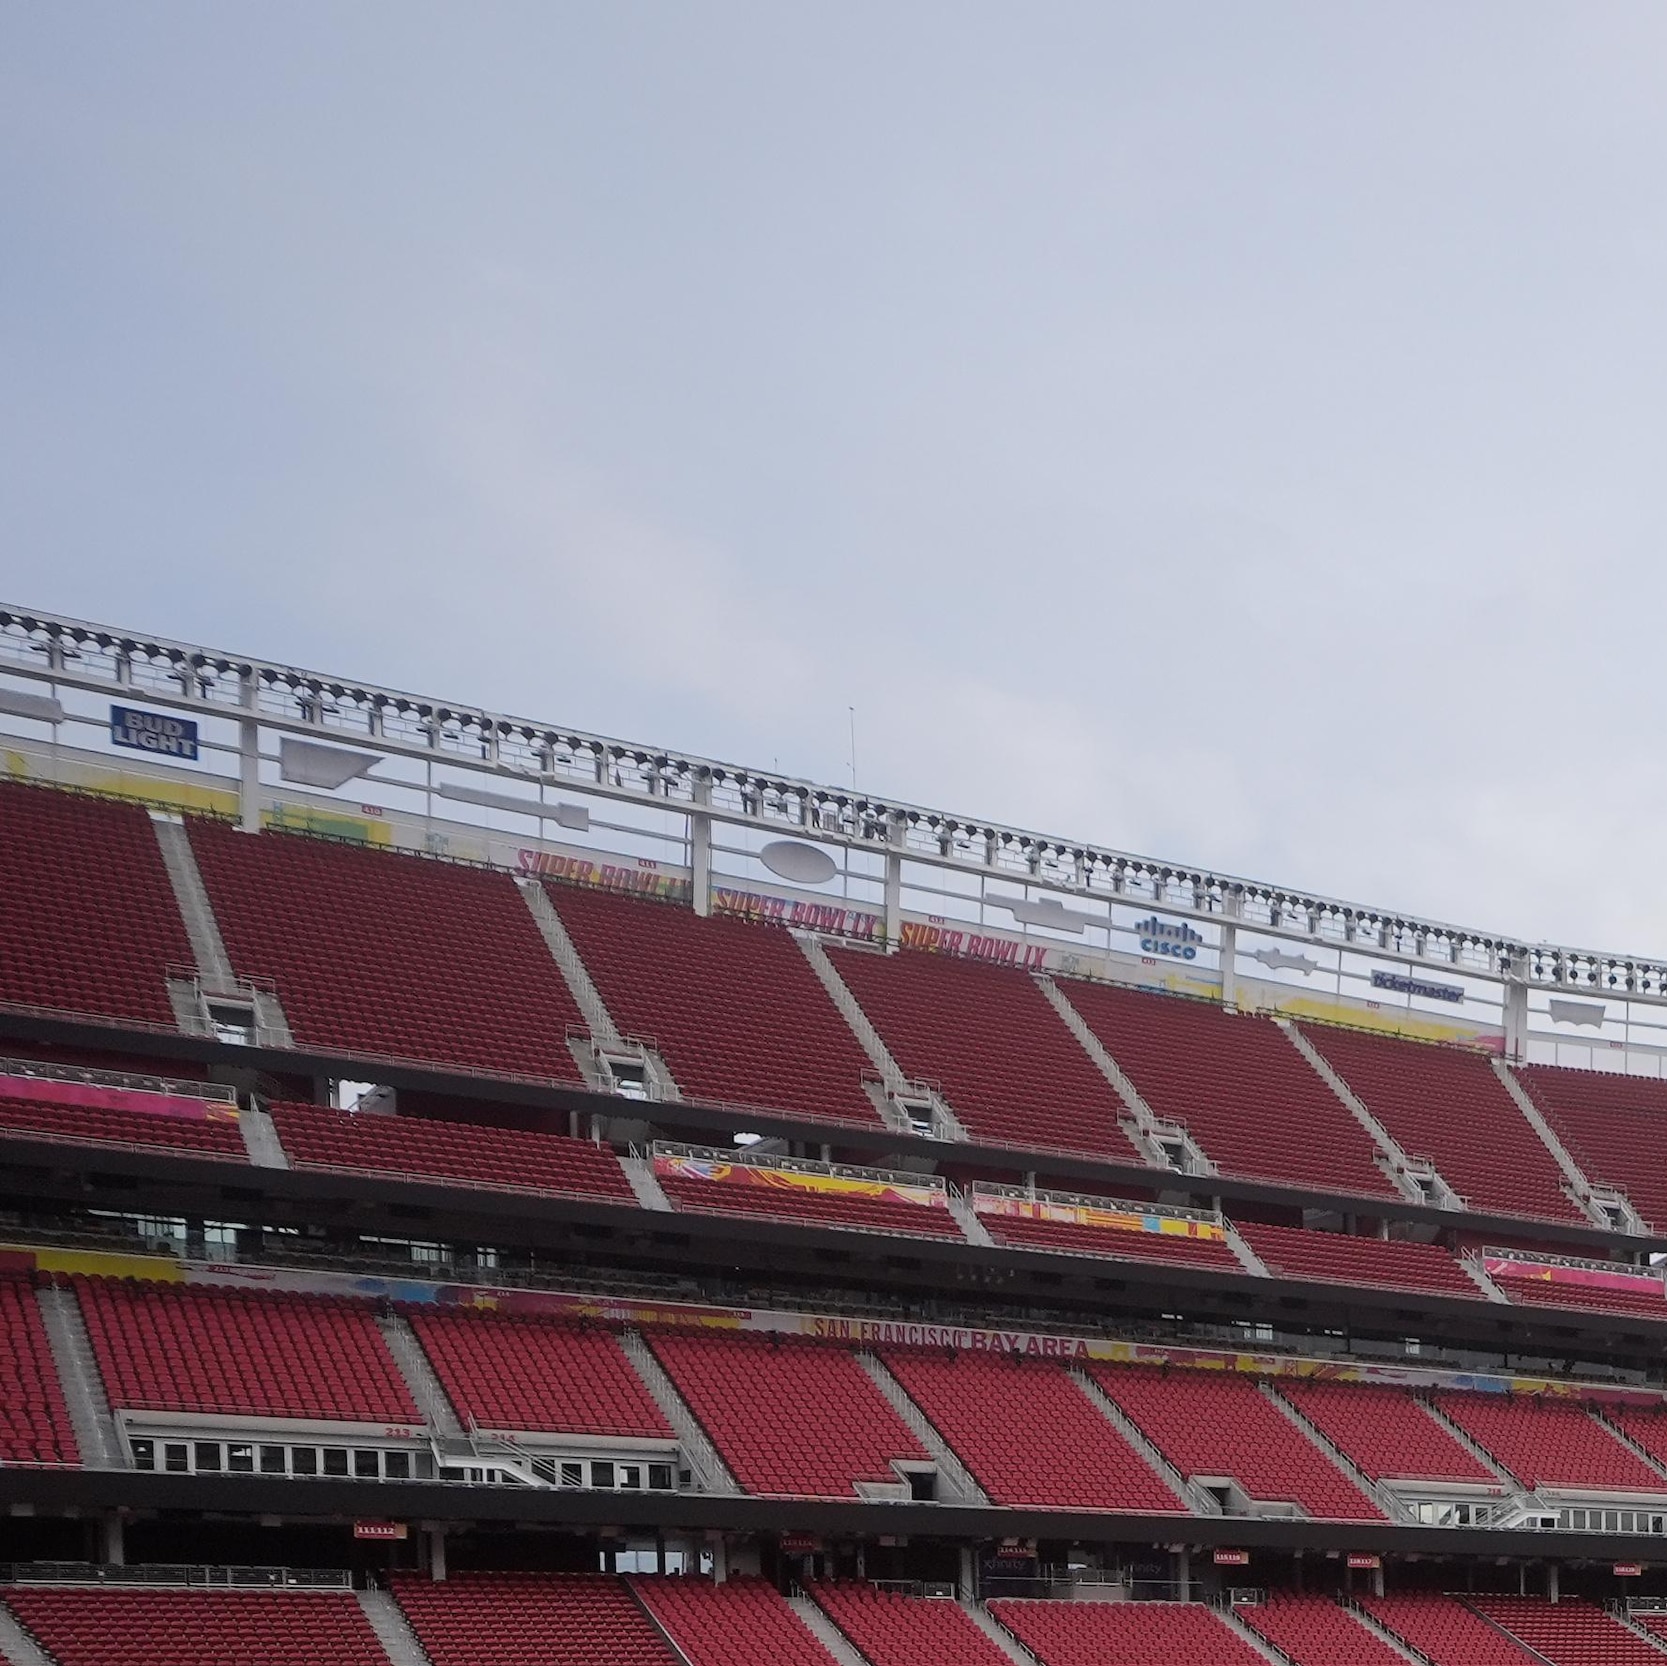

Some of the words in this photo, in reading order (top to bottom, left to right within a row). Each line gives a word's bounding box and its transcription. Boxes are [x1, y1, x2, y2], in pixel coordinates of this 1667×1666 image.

[115, 725, 196, 755] LIGHT
[124, 711, 183, 737] BUD
[518, 848, 595, 882] SUPER
[715, 886, 786, 919] SUPER
[900, 920, 964, 953] SUPER
[1373, 971, 1463, 1002] ticketmaster
[814, 1317, 851, 1338] SAN
[971, 1331, 1023, 1353] BAY
[1026, 1336, 1091, 1359] AREA
